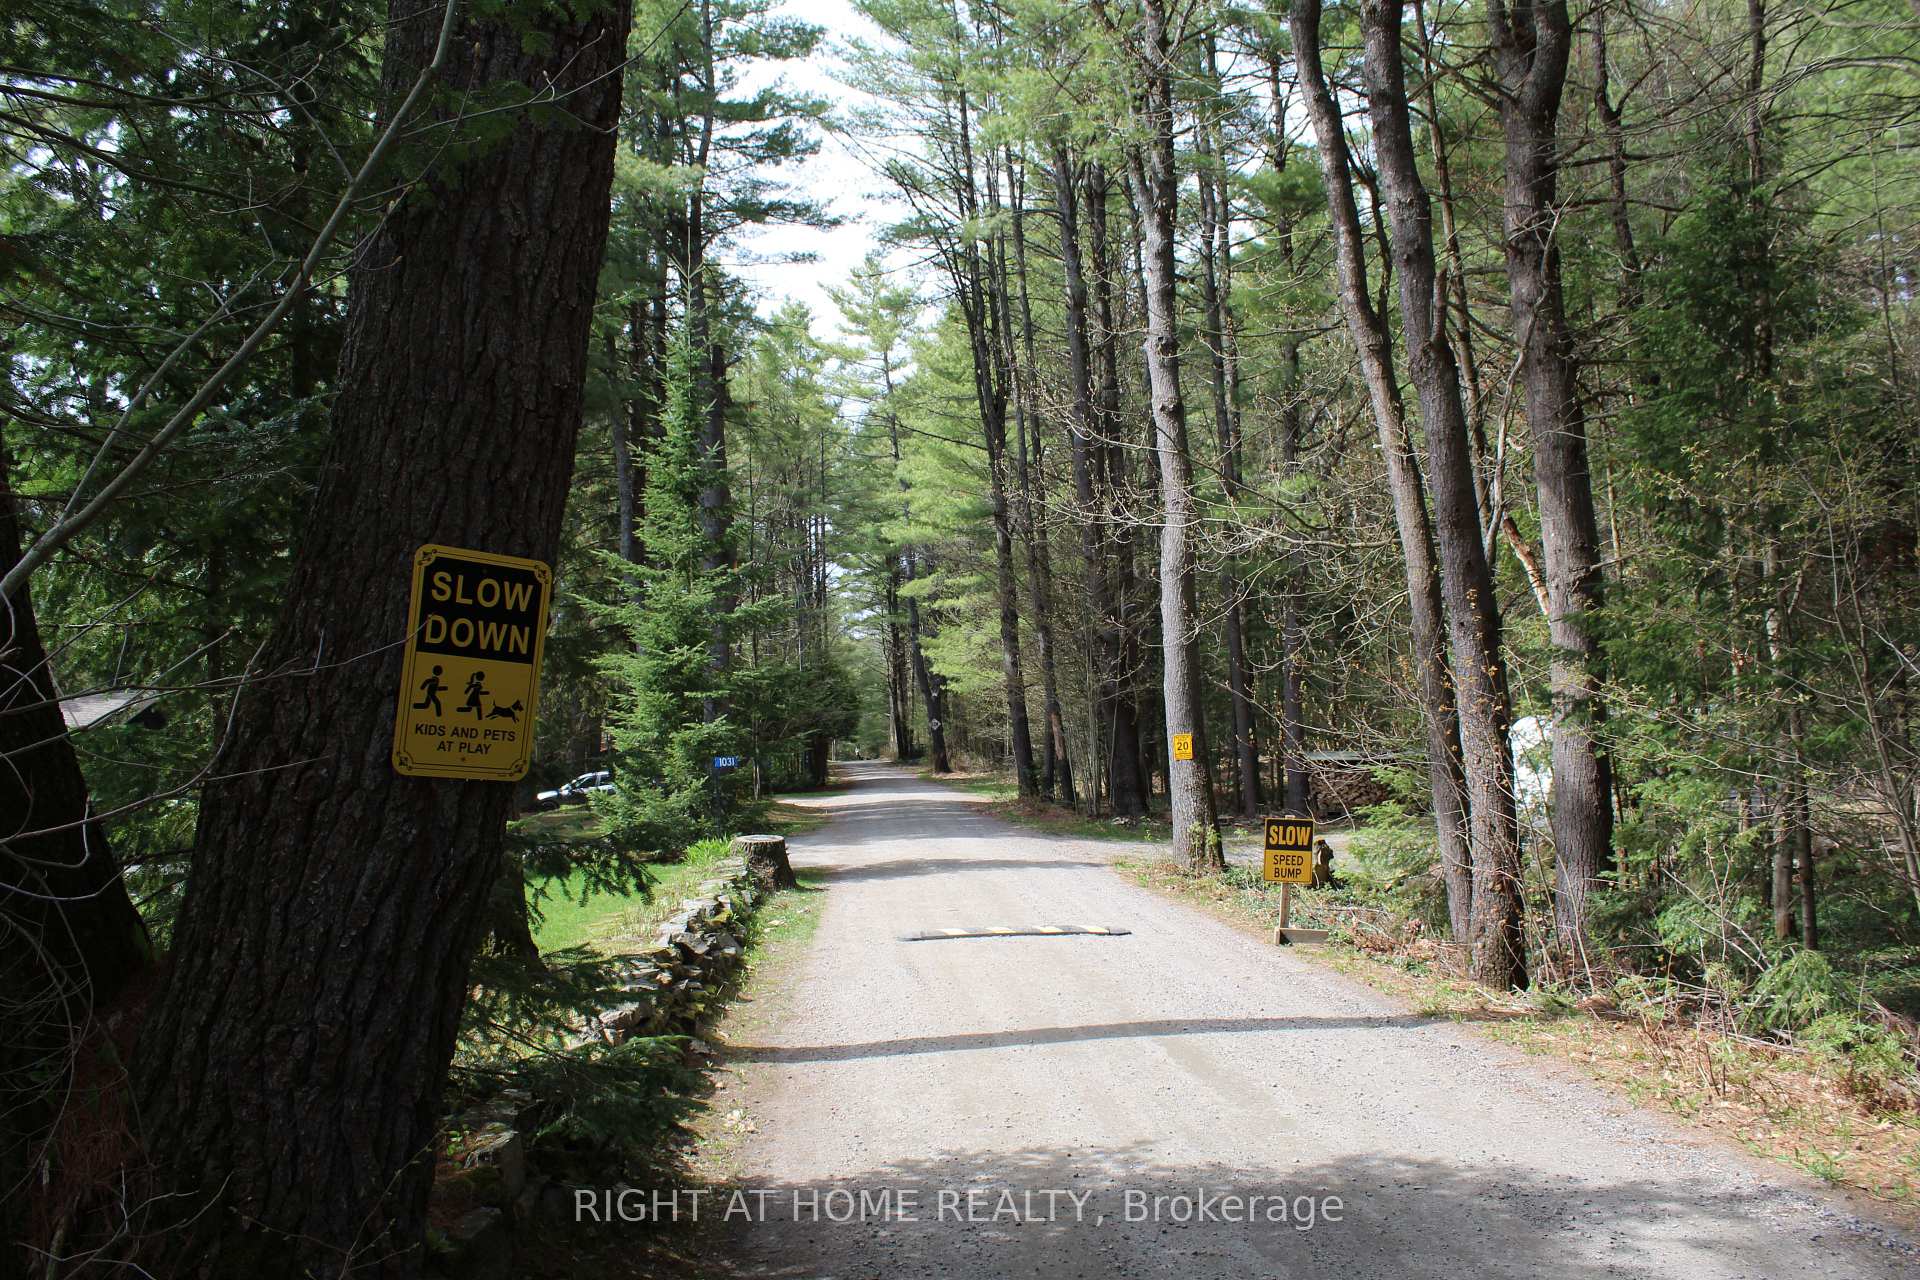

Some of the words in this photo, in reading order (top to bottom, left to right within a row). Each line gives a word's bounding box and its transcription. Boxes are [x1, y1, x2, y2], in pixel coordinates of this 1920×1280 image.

[431, 571, 534, 612] SLOW
[424, 614, 530, 654] DOWN
[415, 723, 446, 736] KIDS
[450, 727, 478, 739] AND
[484, 729, 516, 742] PETS
[437, 740, 453, 752] AT
[458, 742, 492, 755] PLAY
[1177, 741, 1189, 751] 20
[719, 757, 735, 767] 1031
[1269, 825, 1311, 846] SLOW
[1273, 854, 1304, 866] SPEED
[1274, 867, 1302, 878] BUMP
